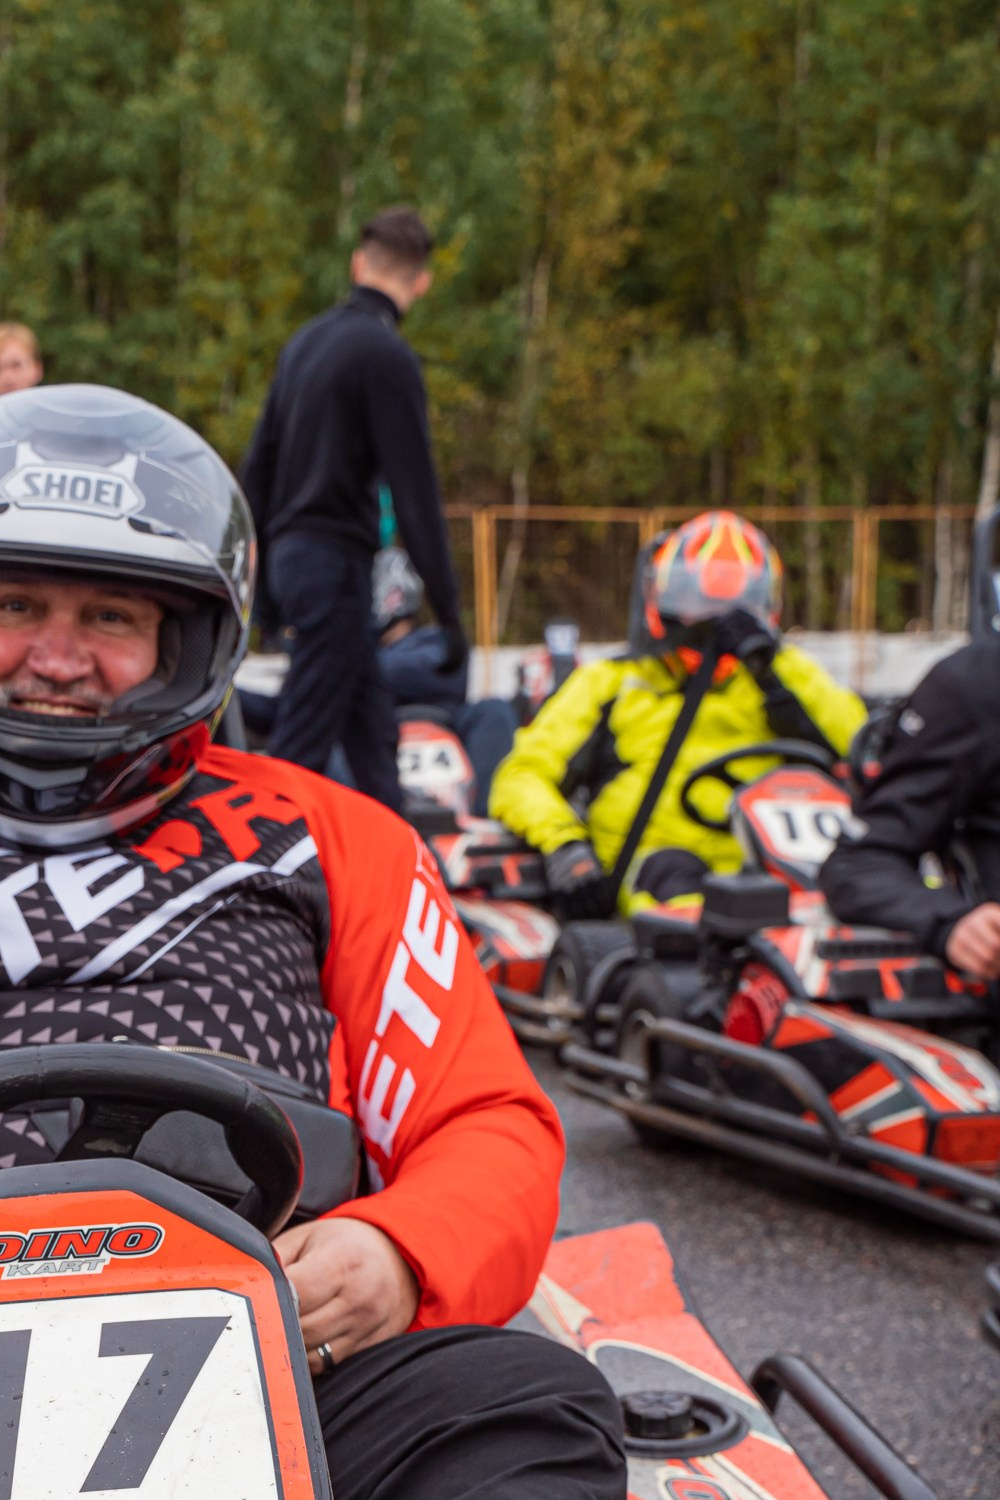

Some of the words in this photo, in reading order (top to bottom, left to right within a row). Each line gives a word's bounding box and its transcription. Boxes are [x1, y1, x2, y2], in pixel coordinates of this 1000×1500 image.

[23, 472, 123, 508] SHOEI
[778, 807, 842, 842] 10
[6, 1258, 106, 1278] KART
